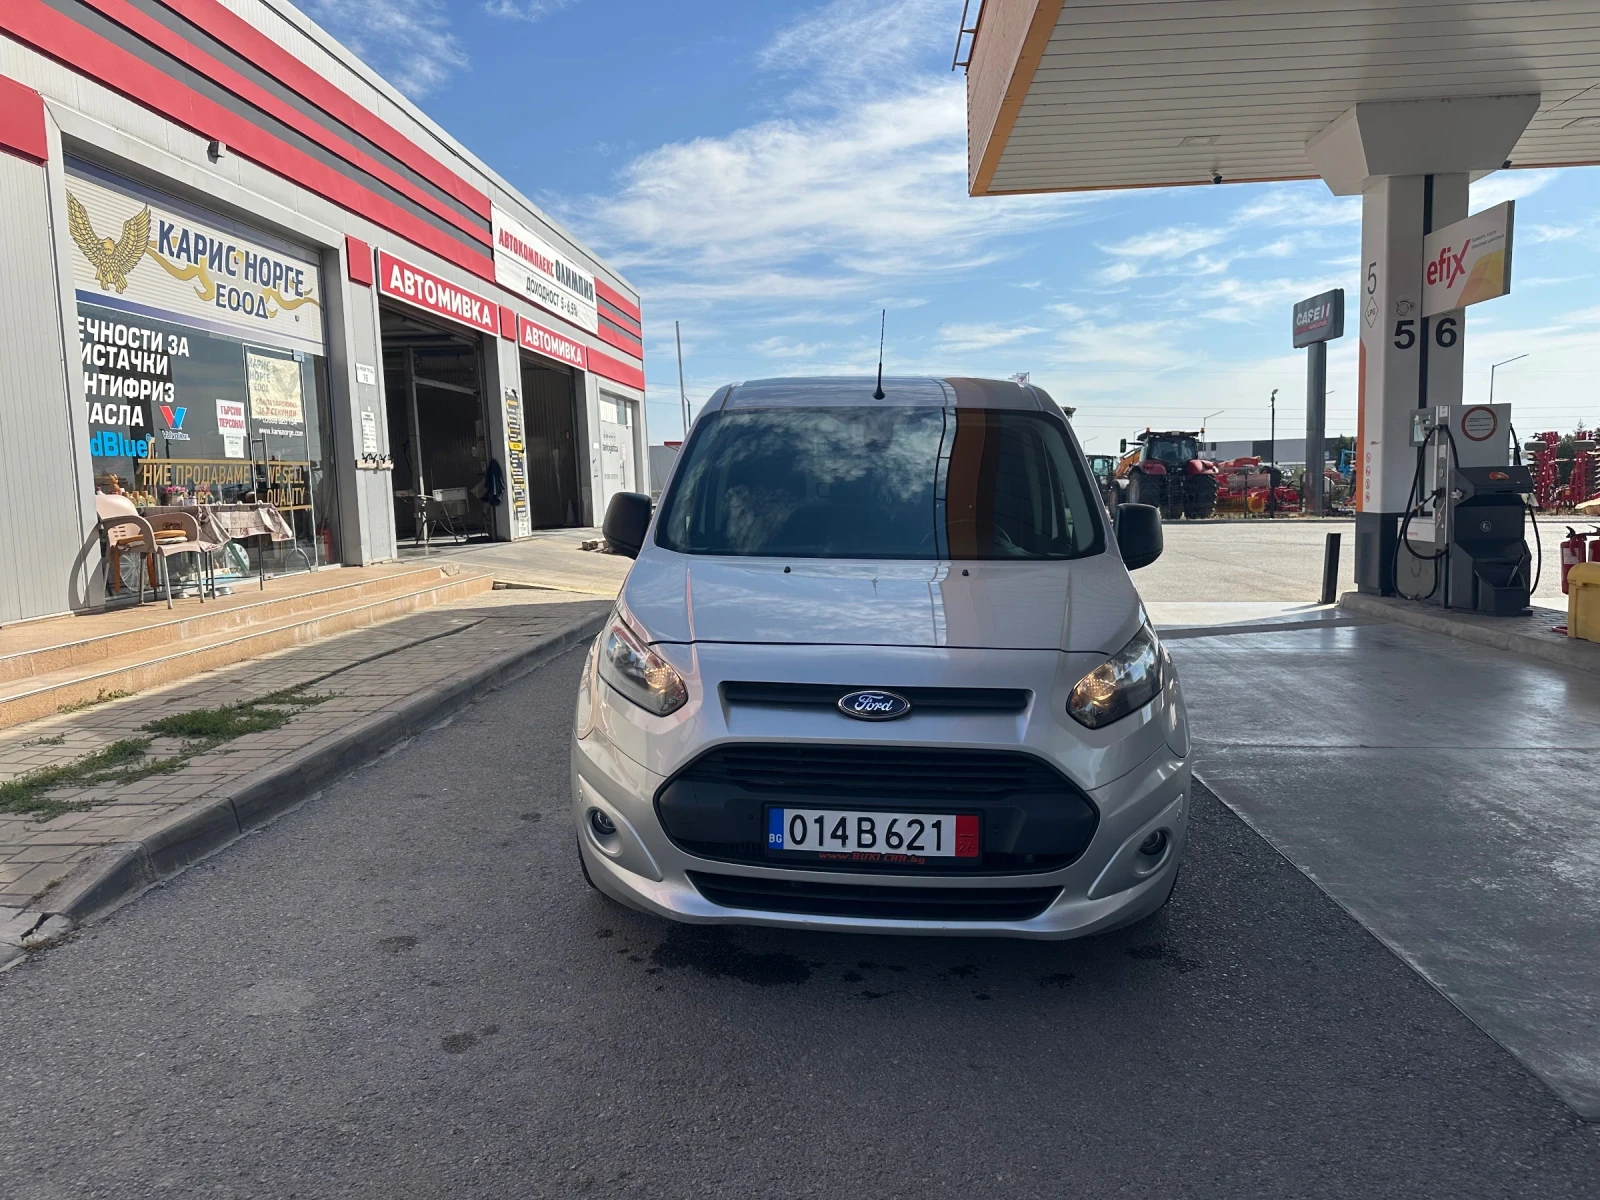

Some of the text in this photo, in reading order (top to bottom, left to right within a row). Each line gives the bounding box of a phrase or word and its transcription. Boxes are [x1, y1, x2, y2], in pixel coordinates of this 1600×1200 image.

[158, 220, 304, 297] КАРИС НОРГЕ
[499, 227, 594, 302] АВТОКОМПЛЕКС ОЛИМПИЯ
[1426, 238, 1471, 289] efix
[526, 276, 560, 307] ДОХОДНОСТ
[1367, 262, 1377, 295] 5
[215, 282, 268, 319] ЕООД
[390, 264, 492, 328] АВТОМИВКА
[1296, 306, 1320, 326] CASE
[167, 335, 189, 357] ЗА
[525, 325, 583, 365] АВТОМИВКА
[1394, 320, 1415, 349] 5
[1435, 318, 1457, 348] 6
[84, 371, 175, 402] НТИФРИЗ
[143, 464, 250, 486] НИЕ ПРОДАВАМЕ
[282, 466, 305, 484] SELL
[266, 487, 306, 506] QUALITY
[854, 694, 893, 712] Ford
[768, 833, 783, 844] BG
